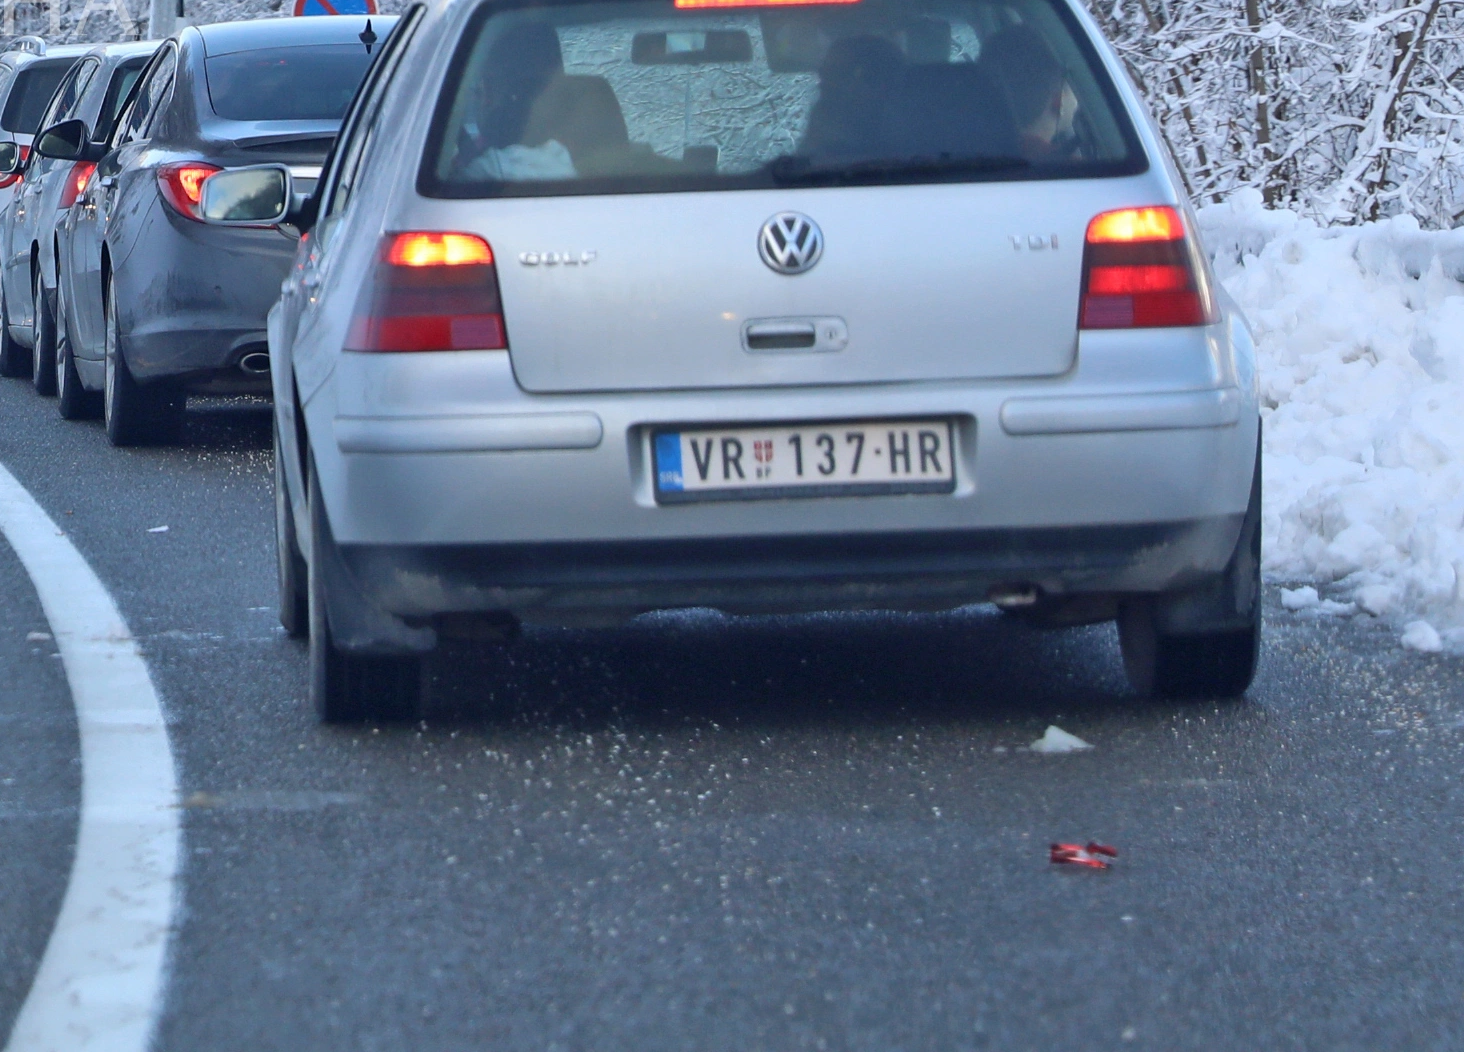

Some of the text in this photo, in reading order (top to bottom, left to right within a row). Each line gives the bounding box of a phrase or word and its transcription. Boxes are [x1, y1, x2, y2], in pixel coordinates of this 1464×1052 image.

[1007, 233, 1058, 250] TDI
[518, 250, 597, 266] GOLF
[689, 436, 745, 481] VR
